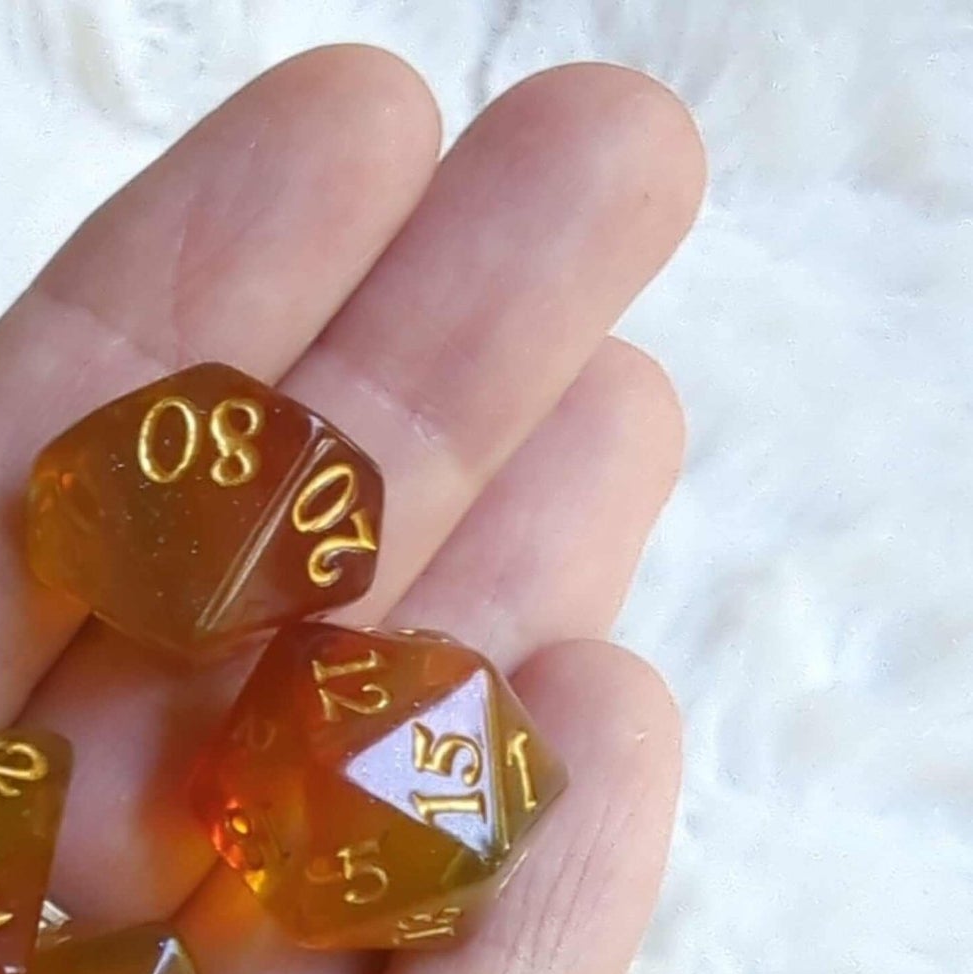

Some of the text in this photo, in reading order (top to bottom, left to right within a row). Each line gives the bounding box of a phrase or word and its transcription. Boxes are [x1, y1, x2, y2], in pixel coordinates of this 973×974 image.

[136, 396, 266, 487] 80
[291, 462, 378, 587] 20
[311, 649, 392, 721] 12
[411, 720, 490, 825] 15
[336, 846, 390, 905] 5
